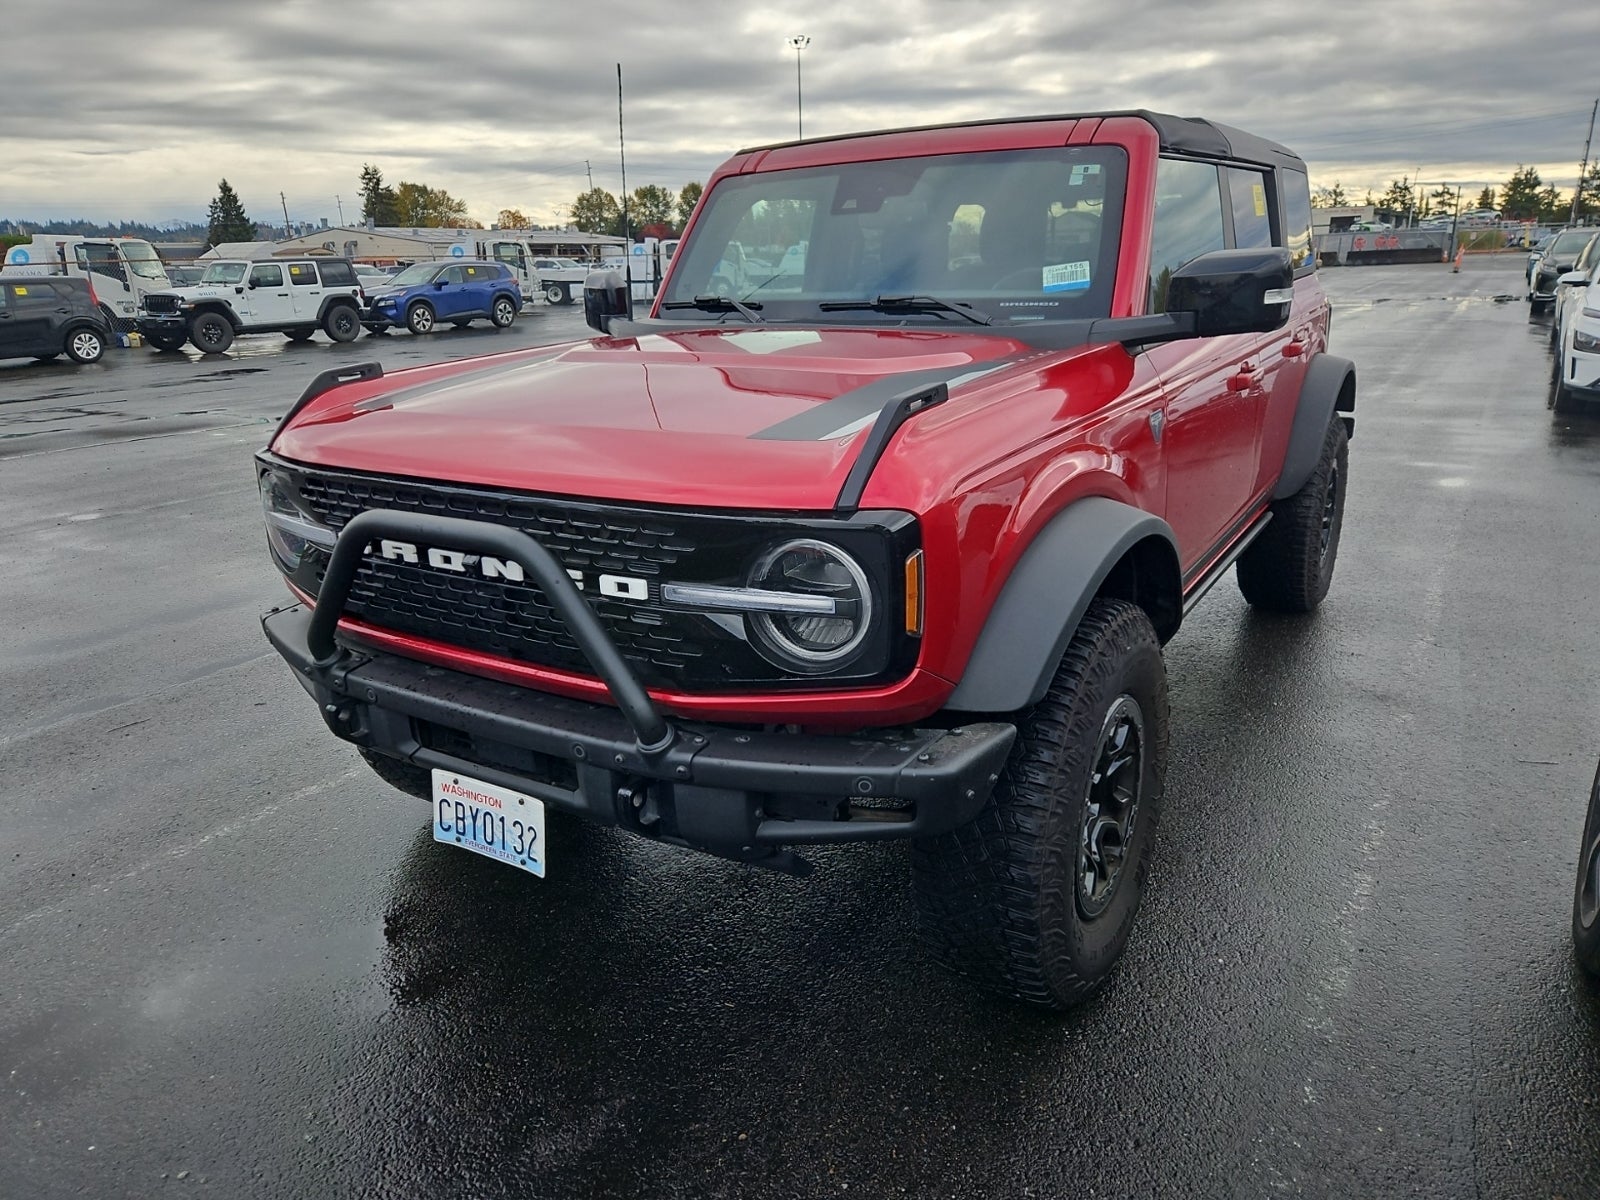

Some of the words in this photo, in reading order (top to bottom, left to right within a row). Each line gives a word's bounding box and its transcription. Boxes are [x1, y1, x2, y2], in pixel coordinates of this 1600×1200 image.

[363, 538, 649, 601] RONO
[441, 783, 502, 809] WASHINGTON
[439, 798, 538, 863] CBY0132
[464, 838, 497, 855] EVERGREEN
[499, 850, 517, 862] STATE
